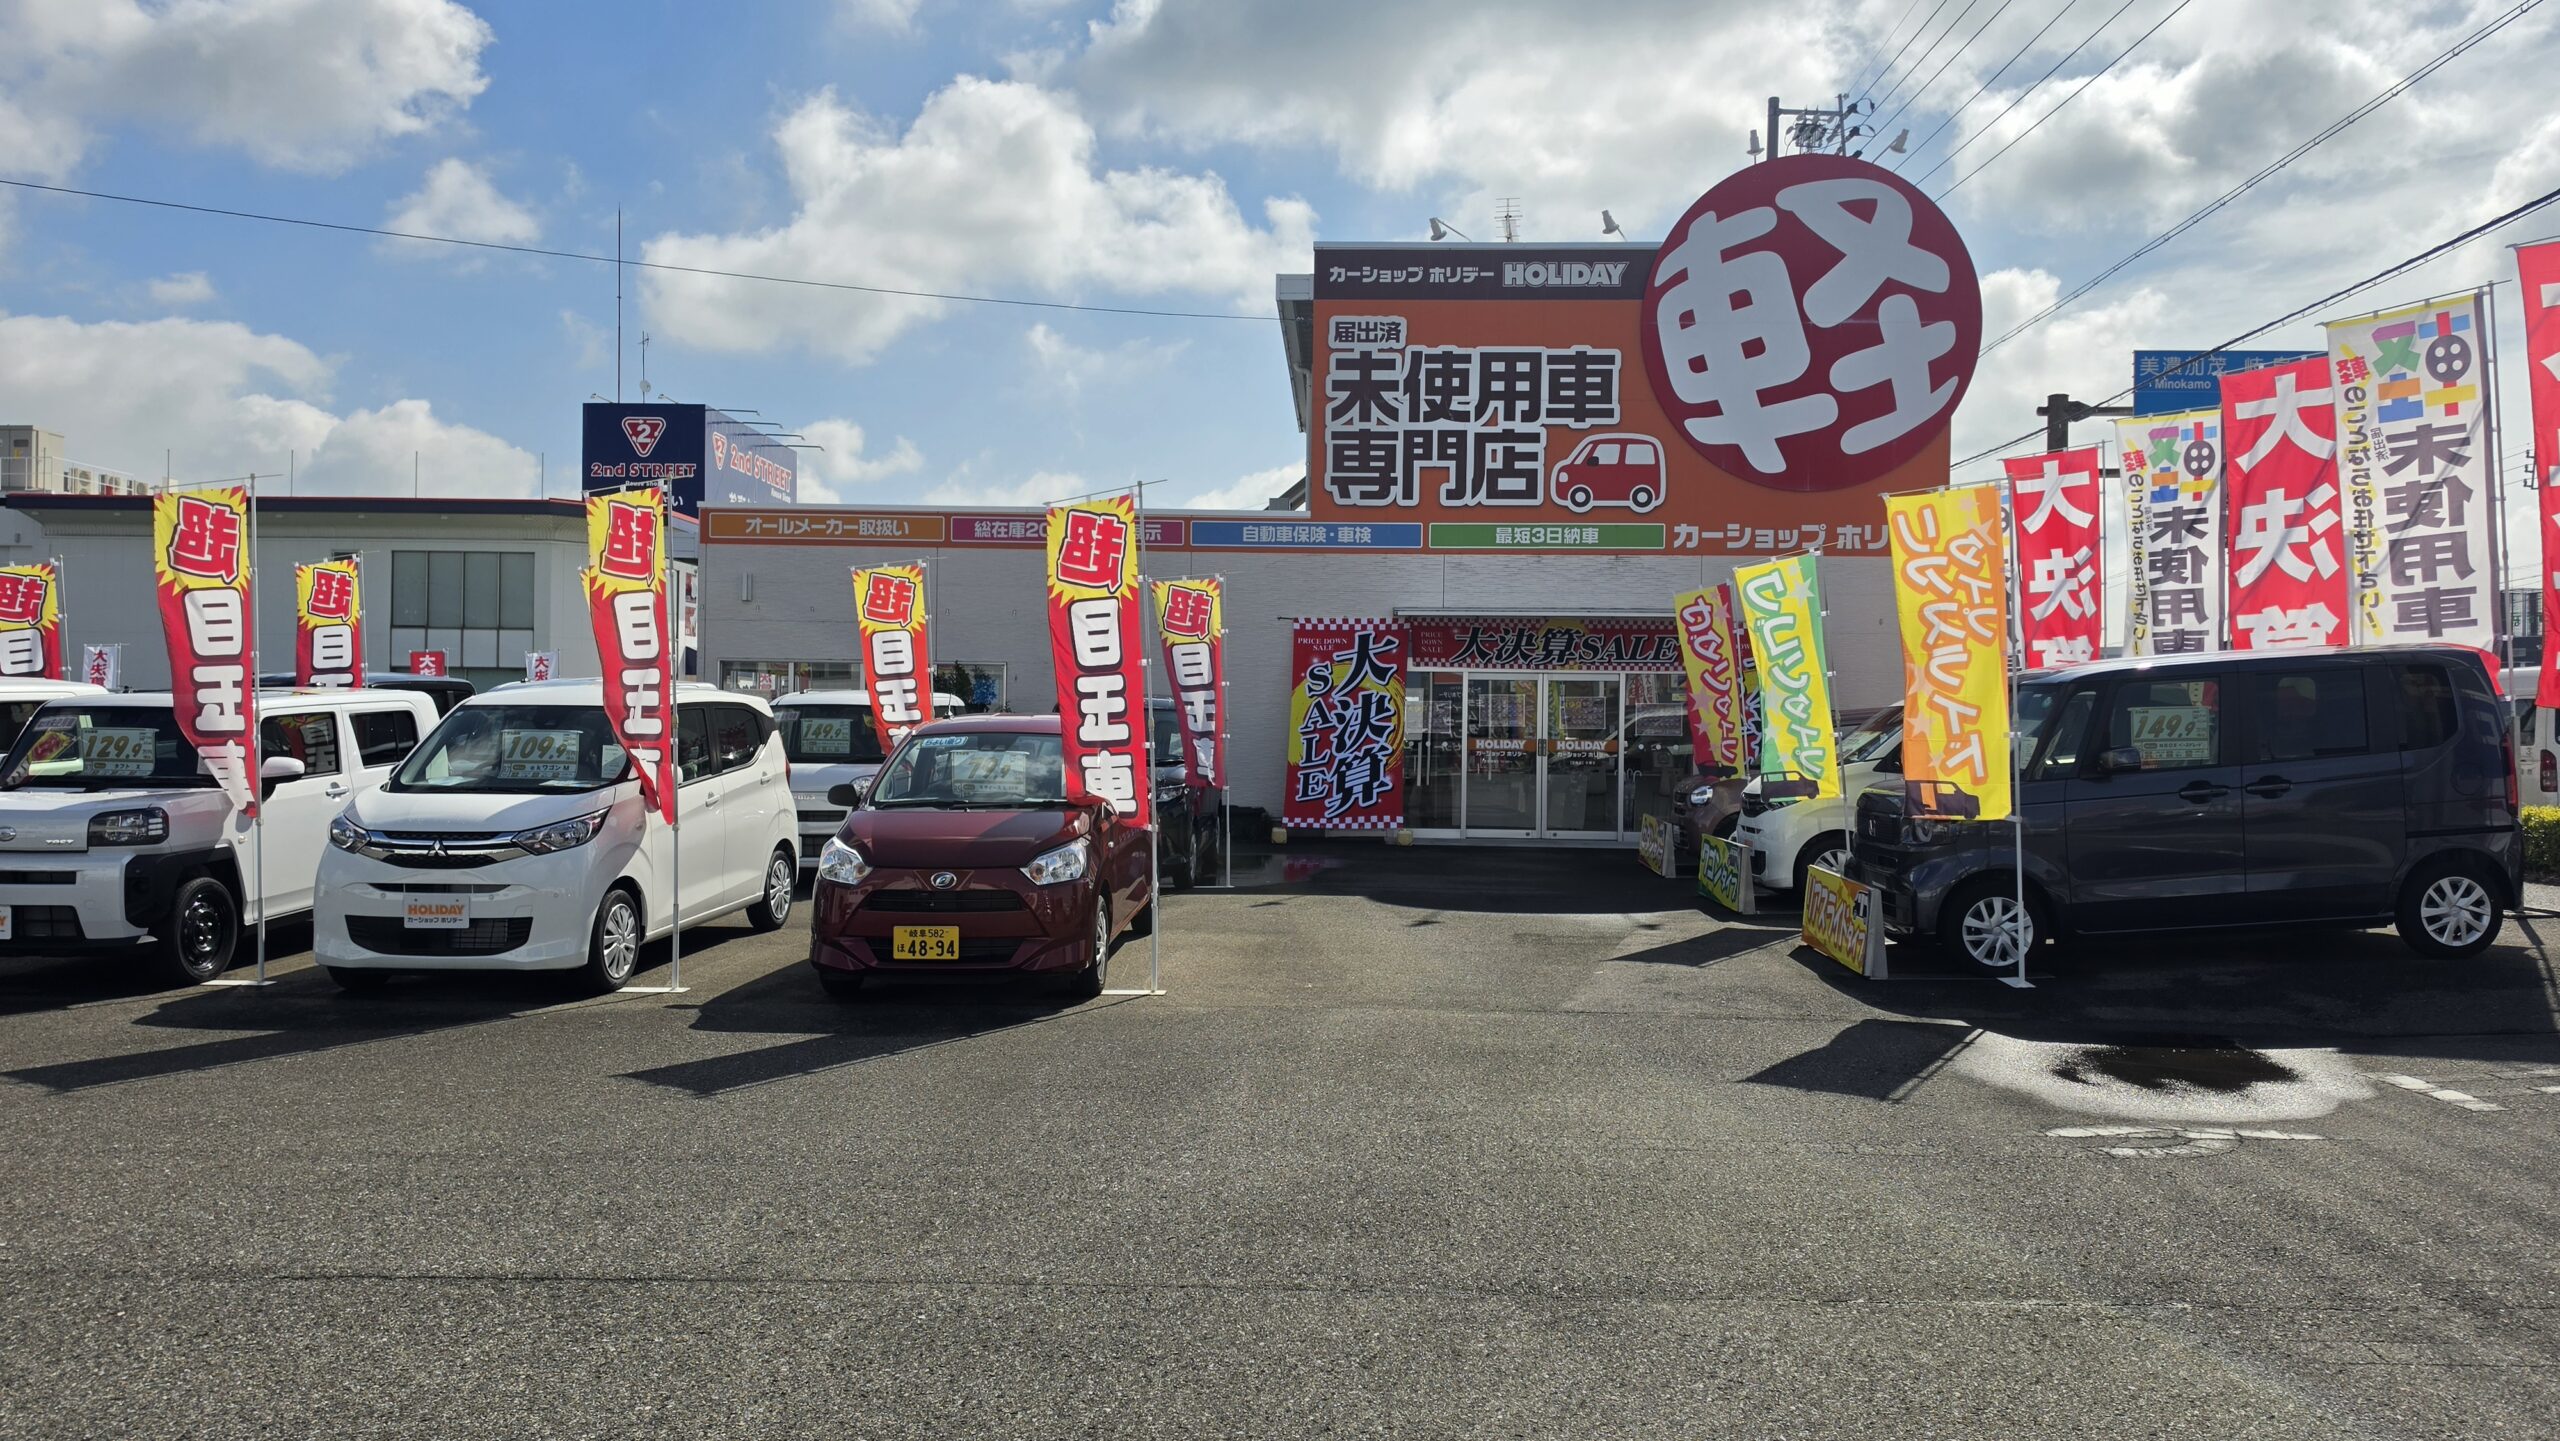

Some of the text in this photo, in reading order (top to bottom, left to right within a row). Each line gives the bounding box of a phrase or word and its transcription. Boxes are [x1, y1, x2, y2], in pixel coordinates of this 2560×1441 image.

[1329, 260, 1630, 288] カーショップ ホリデー HOLIDAY
[1333, 319, 1402, 345] 届出済
[1655, 178, 1960, 474] 軽
[2139, 355, 2228, 377] 美濃加茂
[1328, 348, 1618, 425] 未使用車
[2154, 378, 2212, 390] Minokamo
[590, 462, 697, 478] 2nd STREET
[730, 443, 792, 494] 2nd STREET
[1328, 428, 1545, 505] 専門店
[745, 517, 910, 537] オールメーカー取扱い
[974, 520, 1047, 539] 総在庫20
[1241, 526, 1372, 545] 自動車保険・車検
[1495, 526, 1600, 546] 最短3日納車
[1672, 522, 1888, 550] カーショップ ホリ
[1297, 637, 1348, 646] PRICE DOWN
[1295, 661, 1334, 802] SALE
[1325, 630, 1399, 818] 大決算
[2134, 714, 2196, 738] 149.9
[84, 735, 142, 759] 129.9
[506, 736, 567, 760] 109.9
[1476, 739, 1526, 750] HOLIDAY
[1556, 740, 1607, 751] HOLIDAY
[407, 904, 465, 915] HOLIDAY
[927, 928, 945, 939] 582
[907, 939, 956, 957] 48-94
